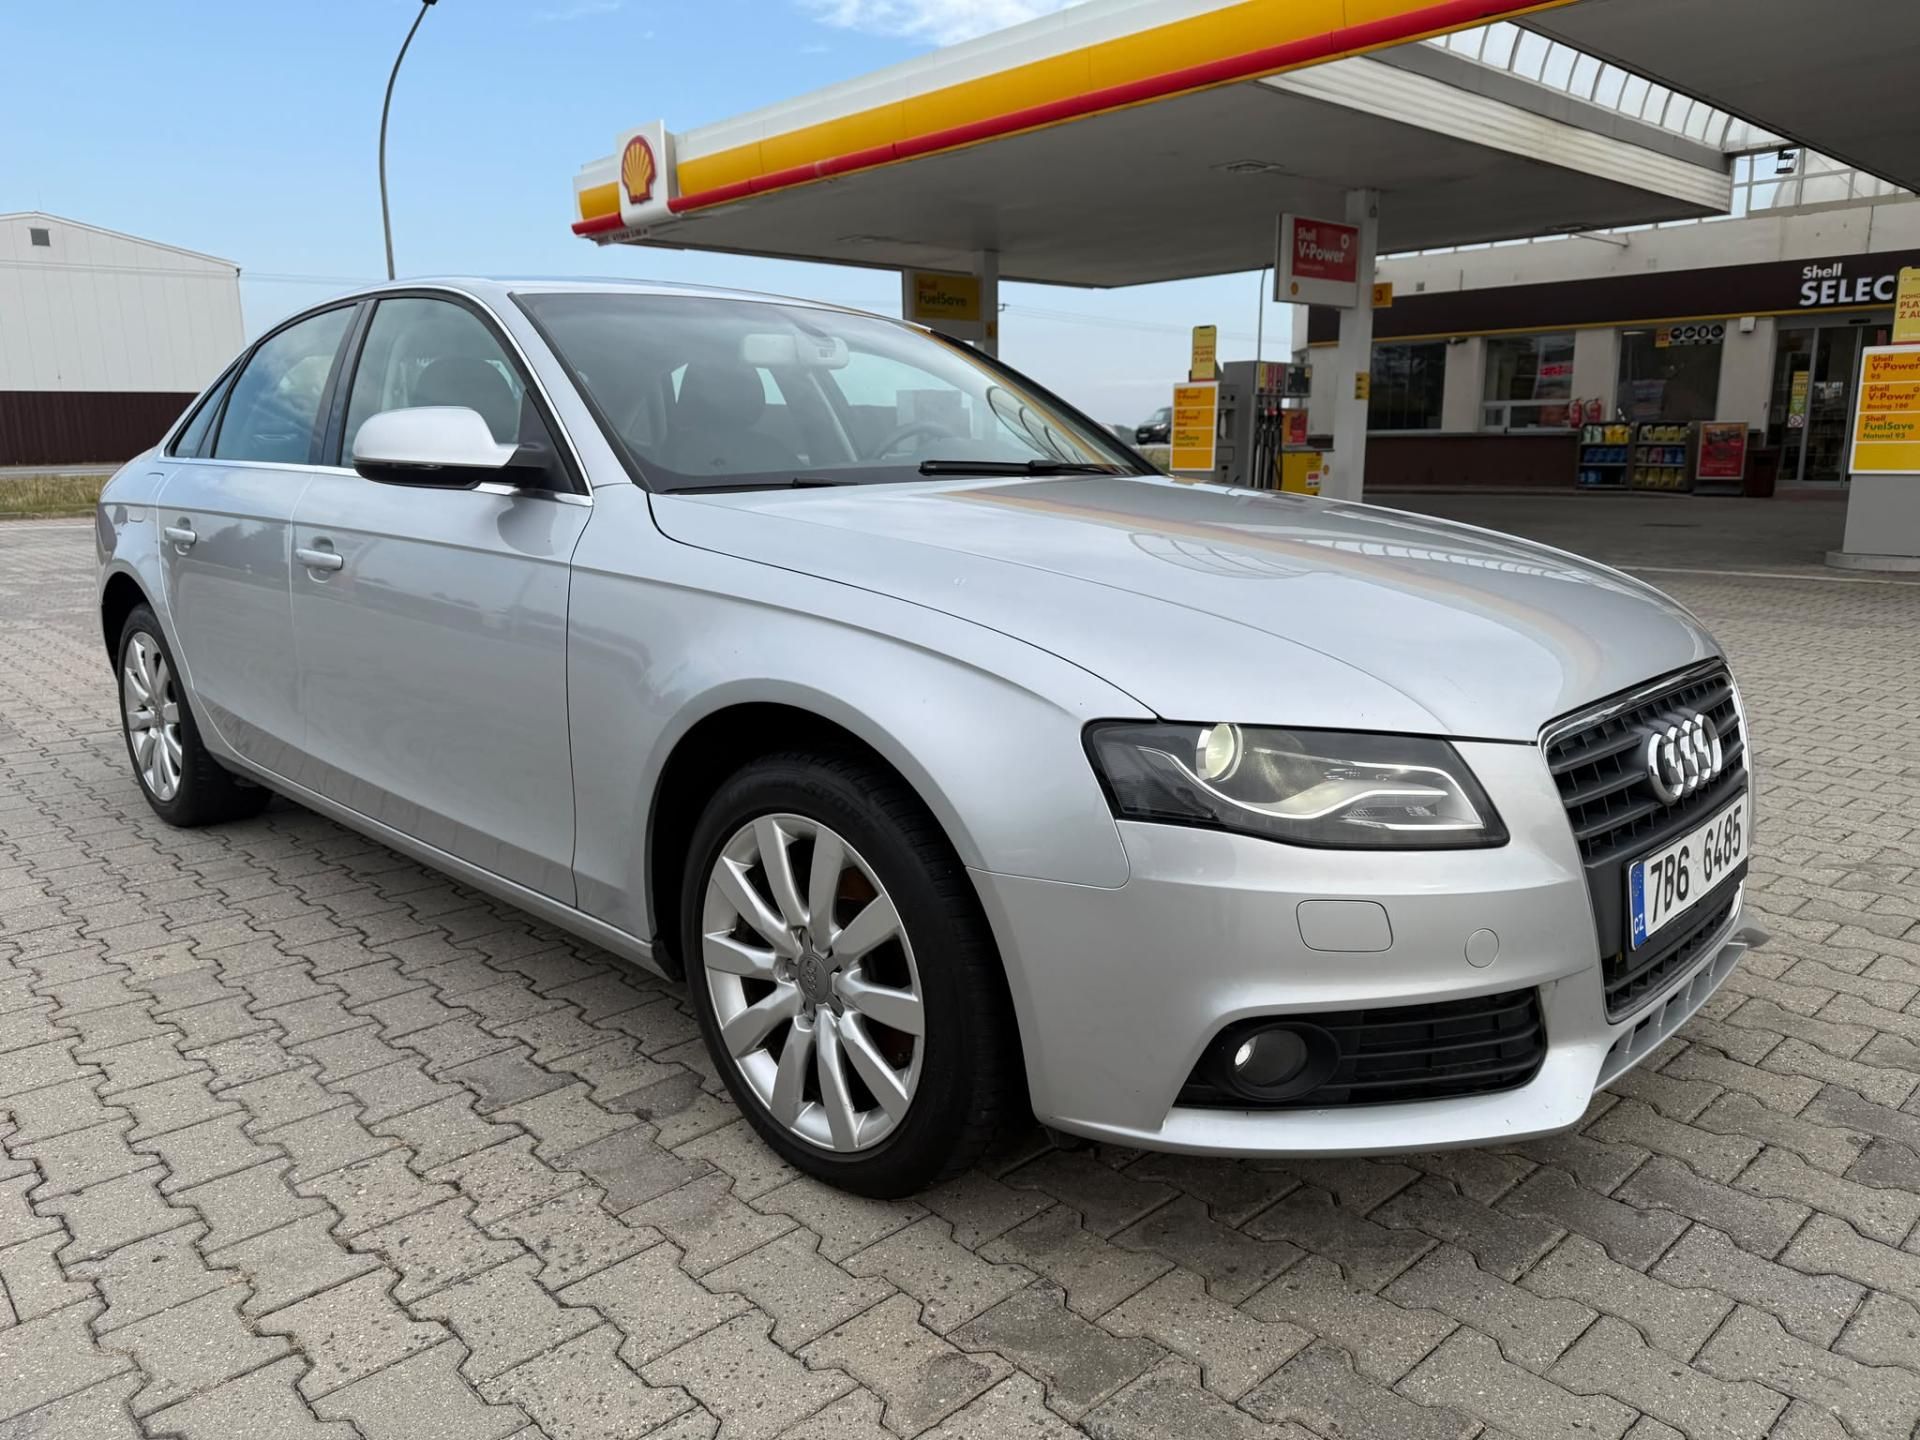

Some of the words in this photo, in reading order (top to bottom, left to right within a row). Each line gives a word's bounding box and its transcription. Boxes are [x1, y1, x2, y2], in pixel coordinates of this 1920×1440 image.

[1298, 241, 1345, 263] V-Power
[1802, 262, 1843, 280] Shell
[1800, 274, 1898, 306] SELEC
[1900, 300, 1920, 309] PLA
[1871, 362, 1920, 371] V-Power
[1869, 384, 1889, 392] Shell
[1868, 392, 1917, 401] V-Power
[1864, 422, 1915, 431] FuelSave
[1650, 845, 1690, 924] 7B6
[1703, 805, 1742, 882] 6485
[1634, 914, 1645, 934] CZ
